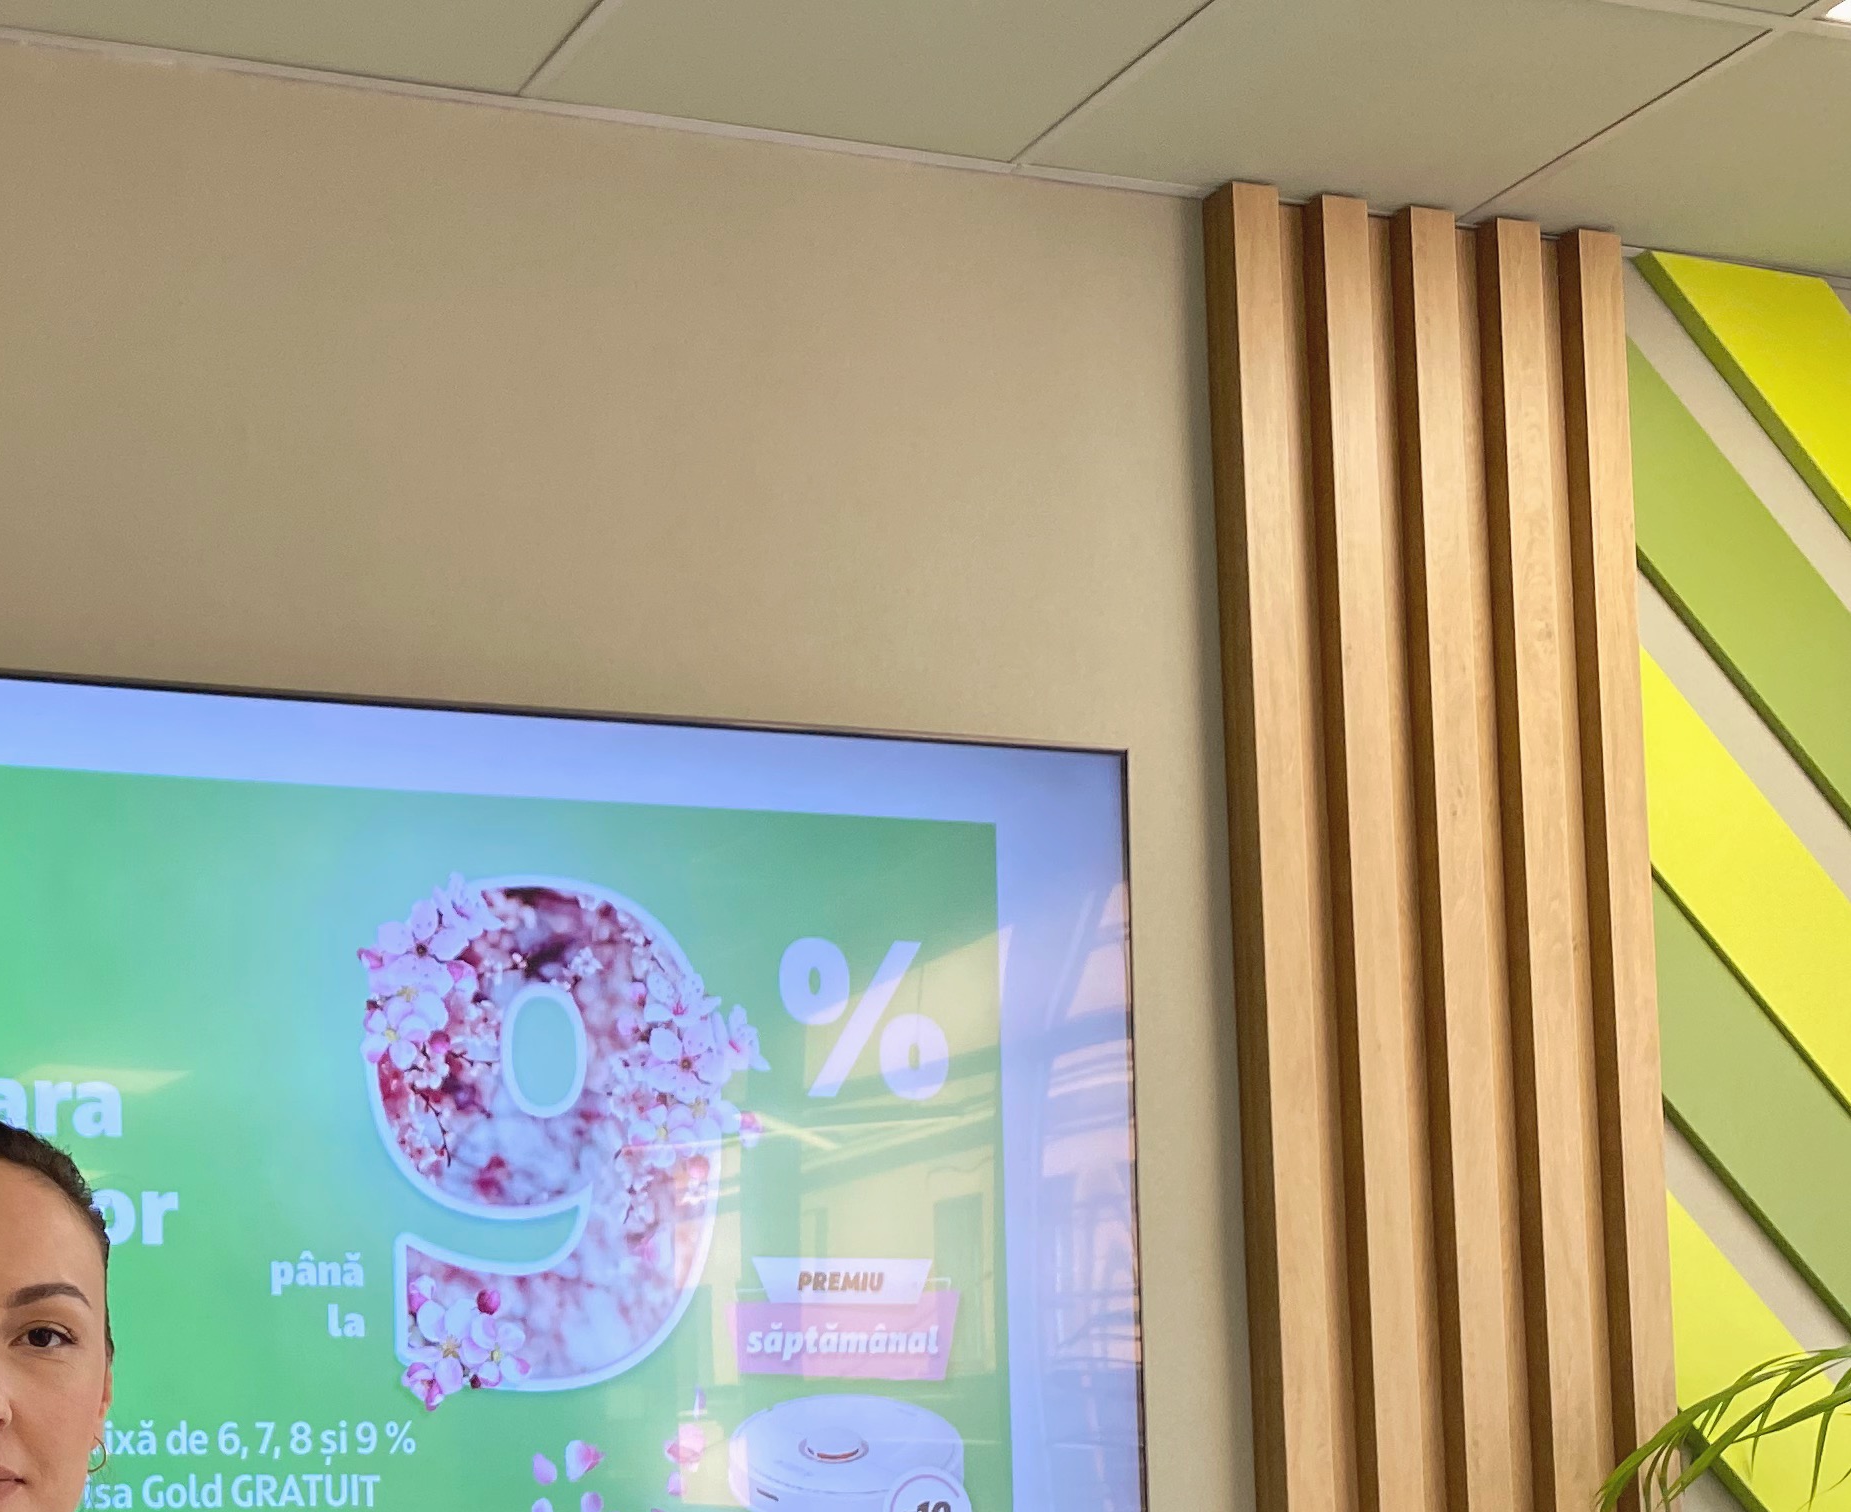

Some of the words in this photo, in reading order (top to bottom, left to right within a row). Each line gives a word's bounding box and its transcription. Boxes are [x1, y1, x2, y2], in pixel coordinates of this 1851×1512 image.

[361, 874, 724, 1392] 9
[779, 936, 950, 1101] %
[270, 1249, 365, 1296] până
[797, 1271, 886, 1292] PREMIU
[327, 1303, 366, 1338] la
[91, 1419, 158, 1457] ixă
[165, 1420, 209, 1456] de
[217, 1421, 248, 1460] 6,
[255, 1421, 281, 1460] 7,
[289, 1421, 313, 1456] 8
[320, 1420, 348, 1466] și
[355, 1421, 379, 1456] 9
[385, 1420, 417, 1456] %
[142, 1473, 223, 1510] Gold
[231, 1473, 381, 1509] GRATUIT
